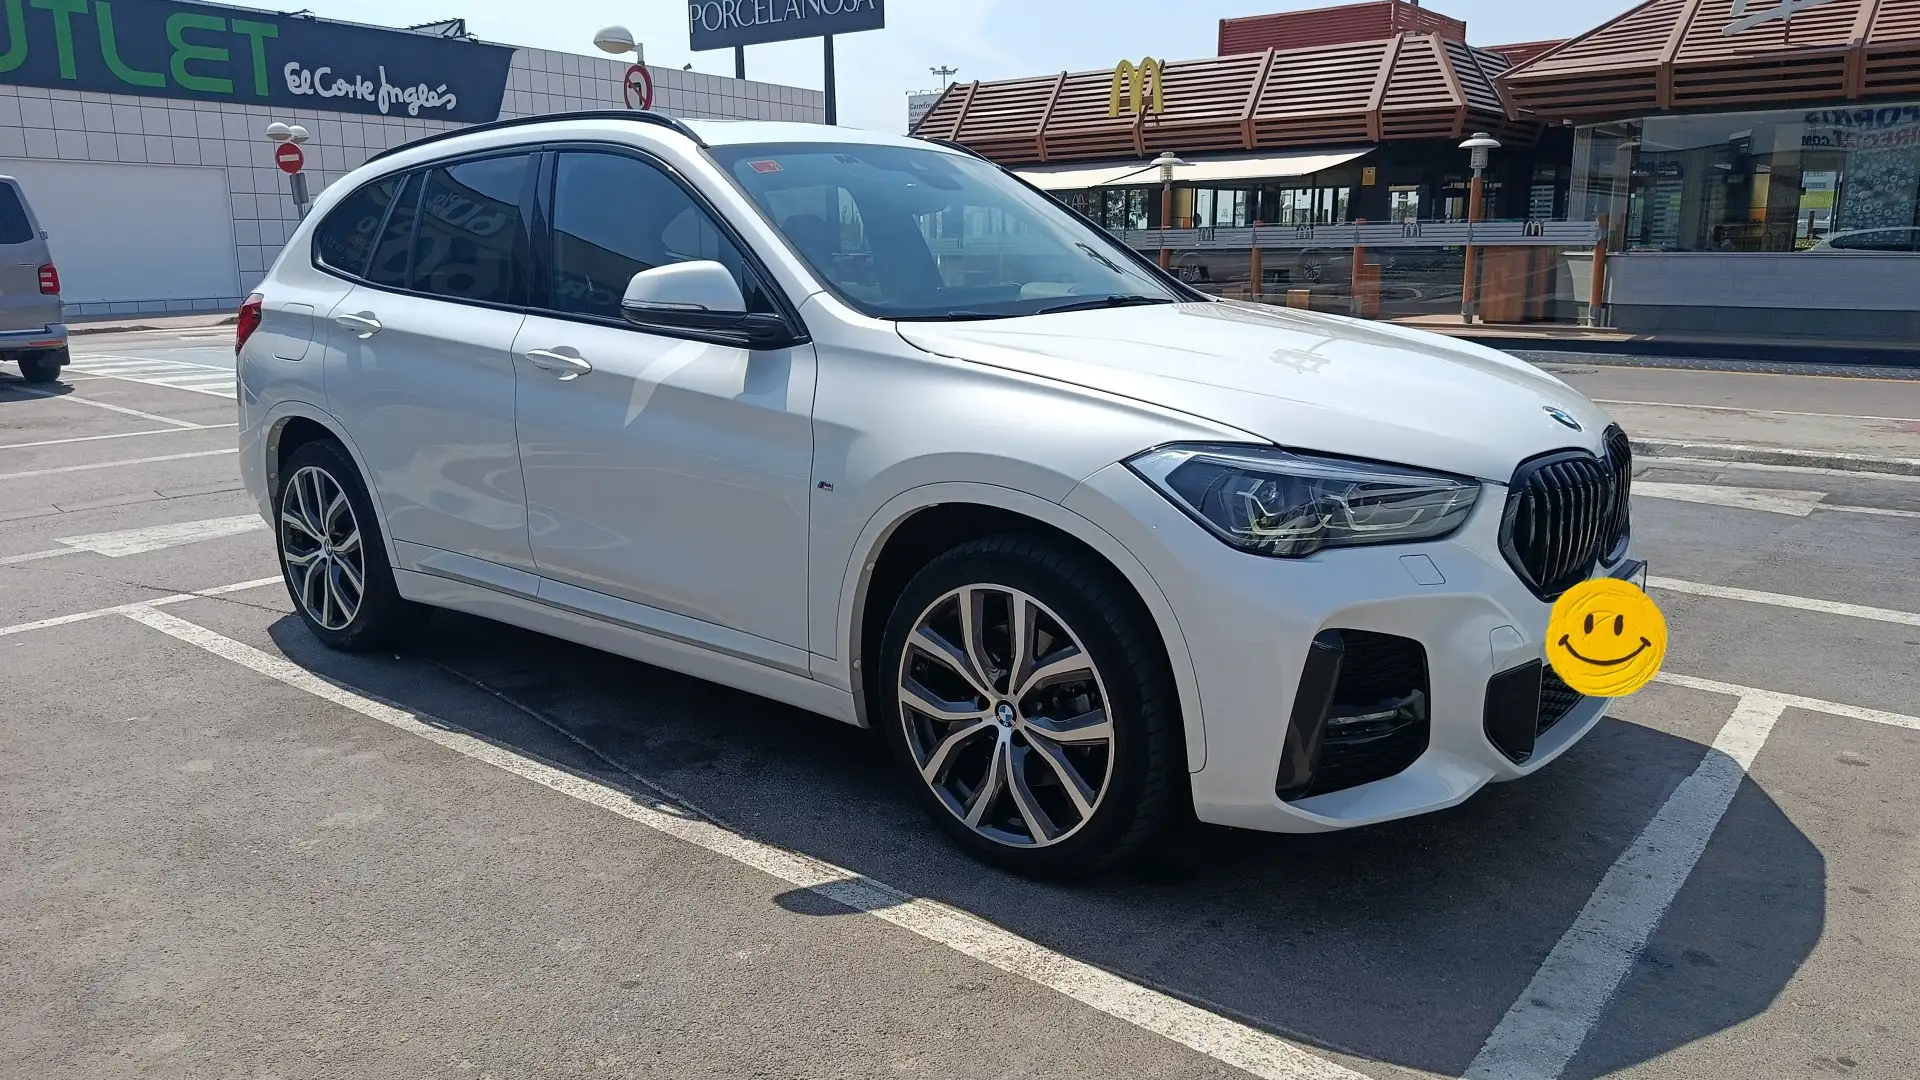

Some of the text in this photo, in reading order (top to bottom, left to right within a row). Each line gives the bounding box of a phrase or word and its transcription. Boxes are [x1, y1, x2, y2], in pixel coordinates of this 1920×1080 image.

[283, 61, 457, 116] El Corte Inglés
[909, 102, 934, 110] Carrefou
